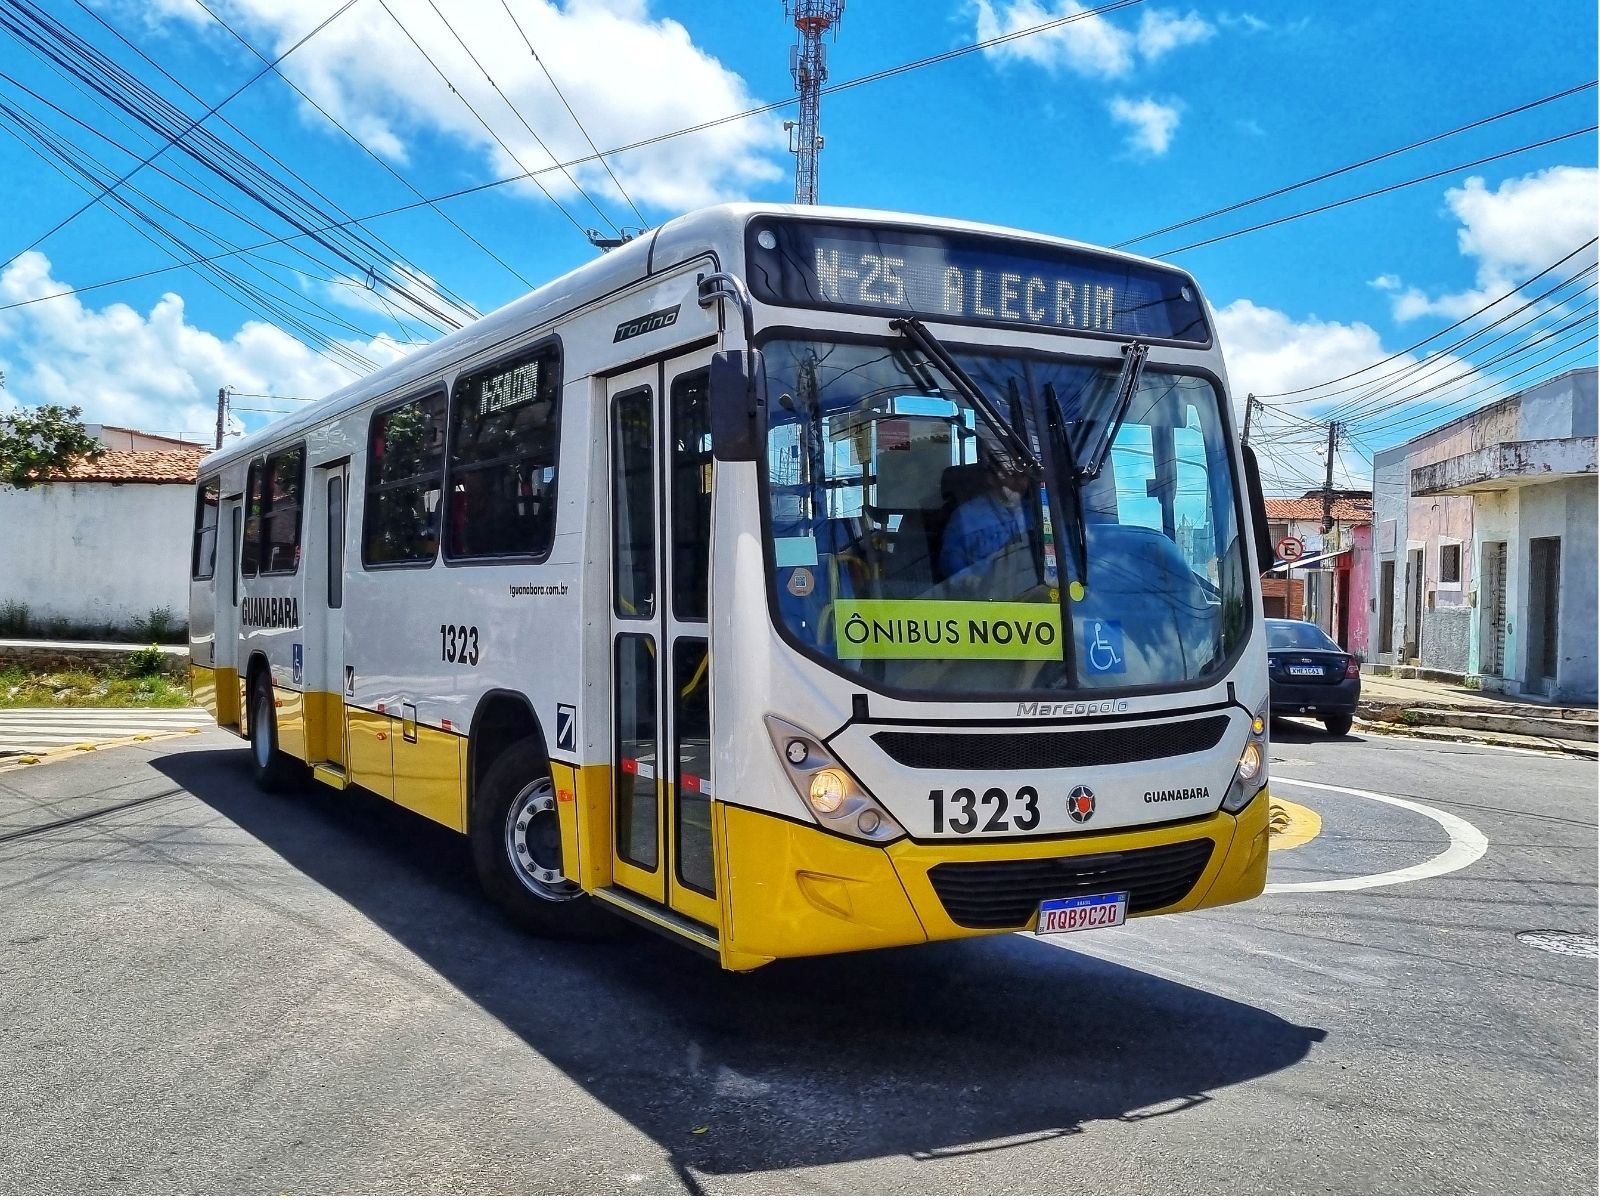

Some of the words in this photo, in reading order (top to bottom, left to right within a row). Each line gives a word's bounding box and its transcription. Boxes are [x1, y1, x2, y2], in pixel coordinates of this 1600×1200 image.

[816, 247, 904, 304] N-25
[943, 265, 1115, 330] ALECRIM
[618, 312, 677, 338] Torino
[1285, 542, 1296, 556] E
[242, 596, 299, 629] GUANABARA
[844, 612, 960, 645] ÔNIBUS
[968, 620, 1056, 646] NOVO
[440, 624, 479, 666] 1323
[1016, 699, 1129, 717] Marcopolo
[928, 785, 1041, 834] 1323
[1143, 786, 1210, 804] GUANABARA
